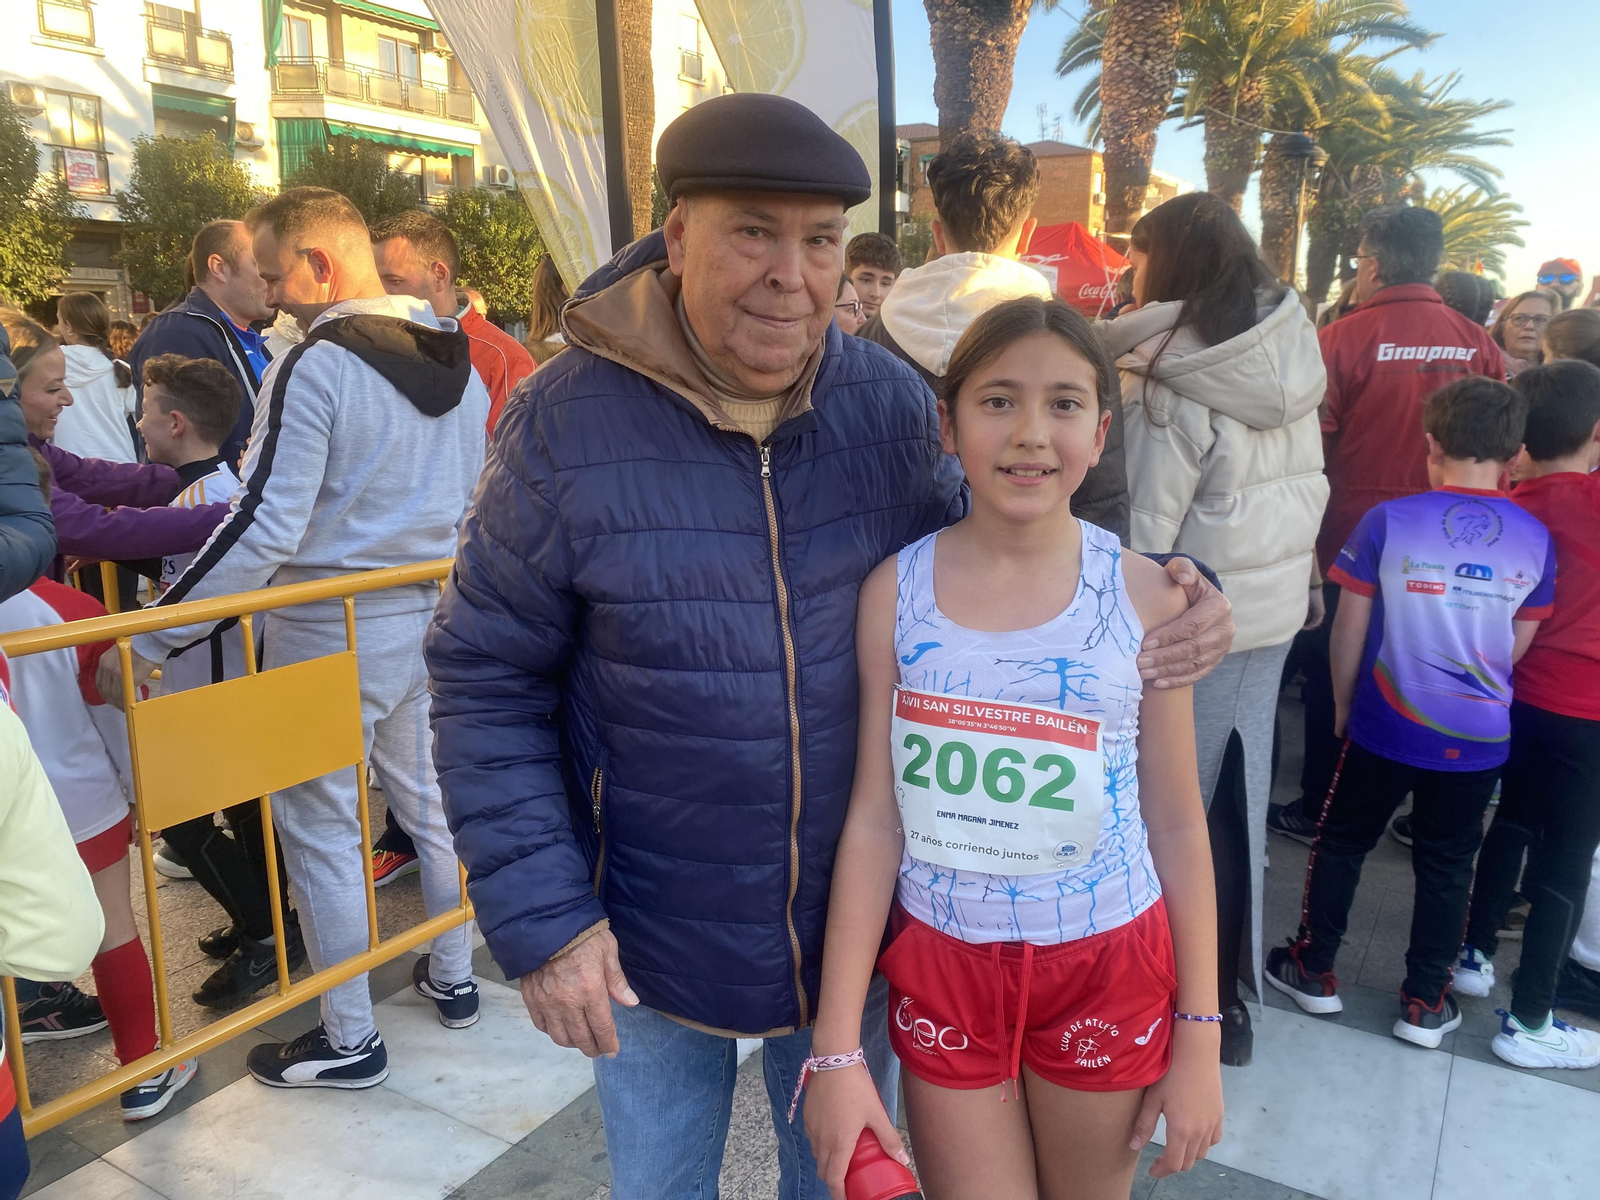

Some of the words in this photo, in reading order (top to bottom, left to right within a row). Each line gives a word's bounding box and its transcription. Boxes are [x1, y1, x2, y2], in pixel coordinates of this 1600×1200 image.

[1376, 342, 1478, 363] Graupner
[922, 699, 950, 714] SAN
[952, 703, 1031, 724] SILVESTRE
[902, 733, 1077, 813] 2062
[936, 810, 956, 820] ENMA
[957, 813, 987, 826] MAGAÑA
[988, 819, 1019, 831] JIMENEZ
[910, 830, 920, 840] 27
[921, 834, 943, 848] años
[945, 839, 1000, 857] corriendo
[1001, 847, 1040, 862] juntos
[454, 985, 473, 996] PUMA
[1060, 1030, 1072, 1052] CLUB
[1069, 1020, 1083, 1033] DE
[1074, 1054, 1112, 1068] BAILÉN
